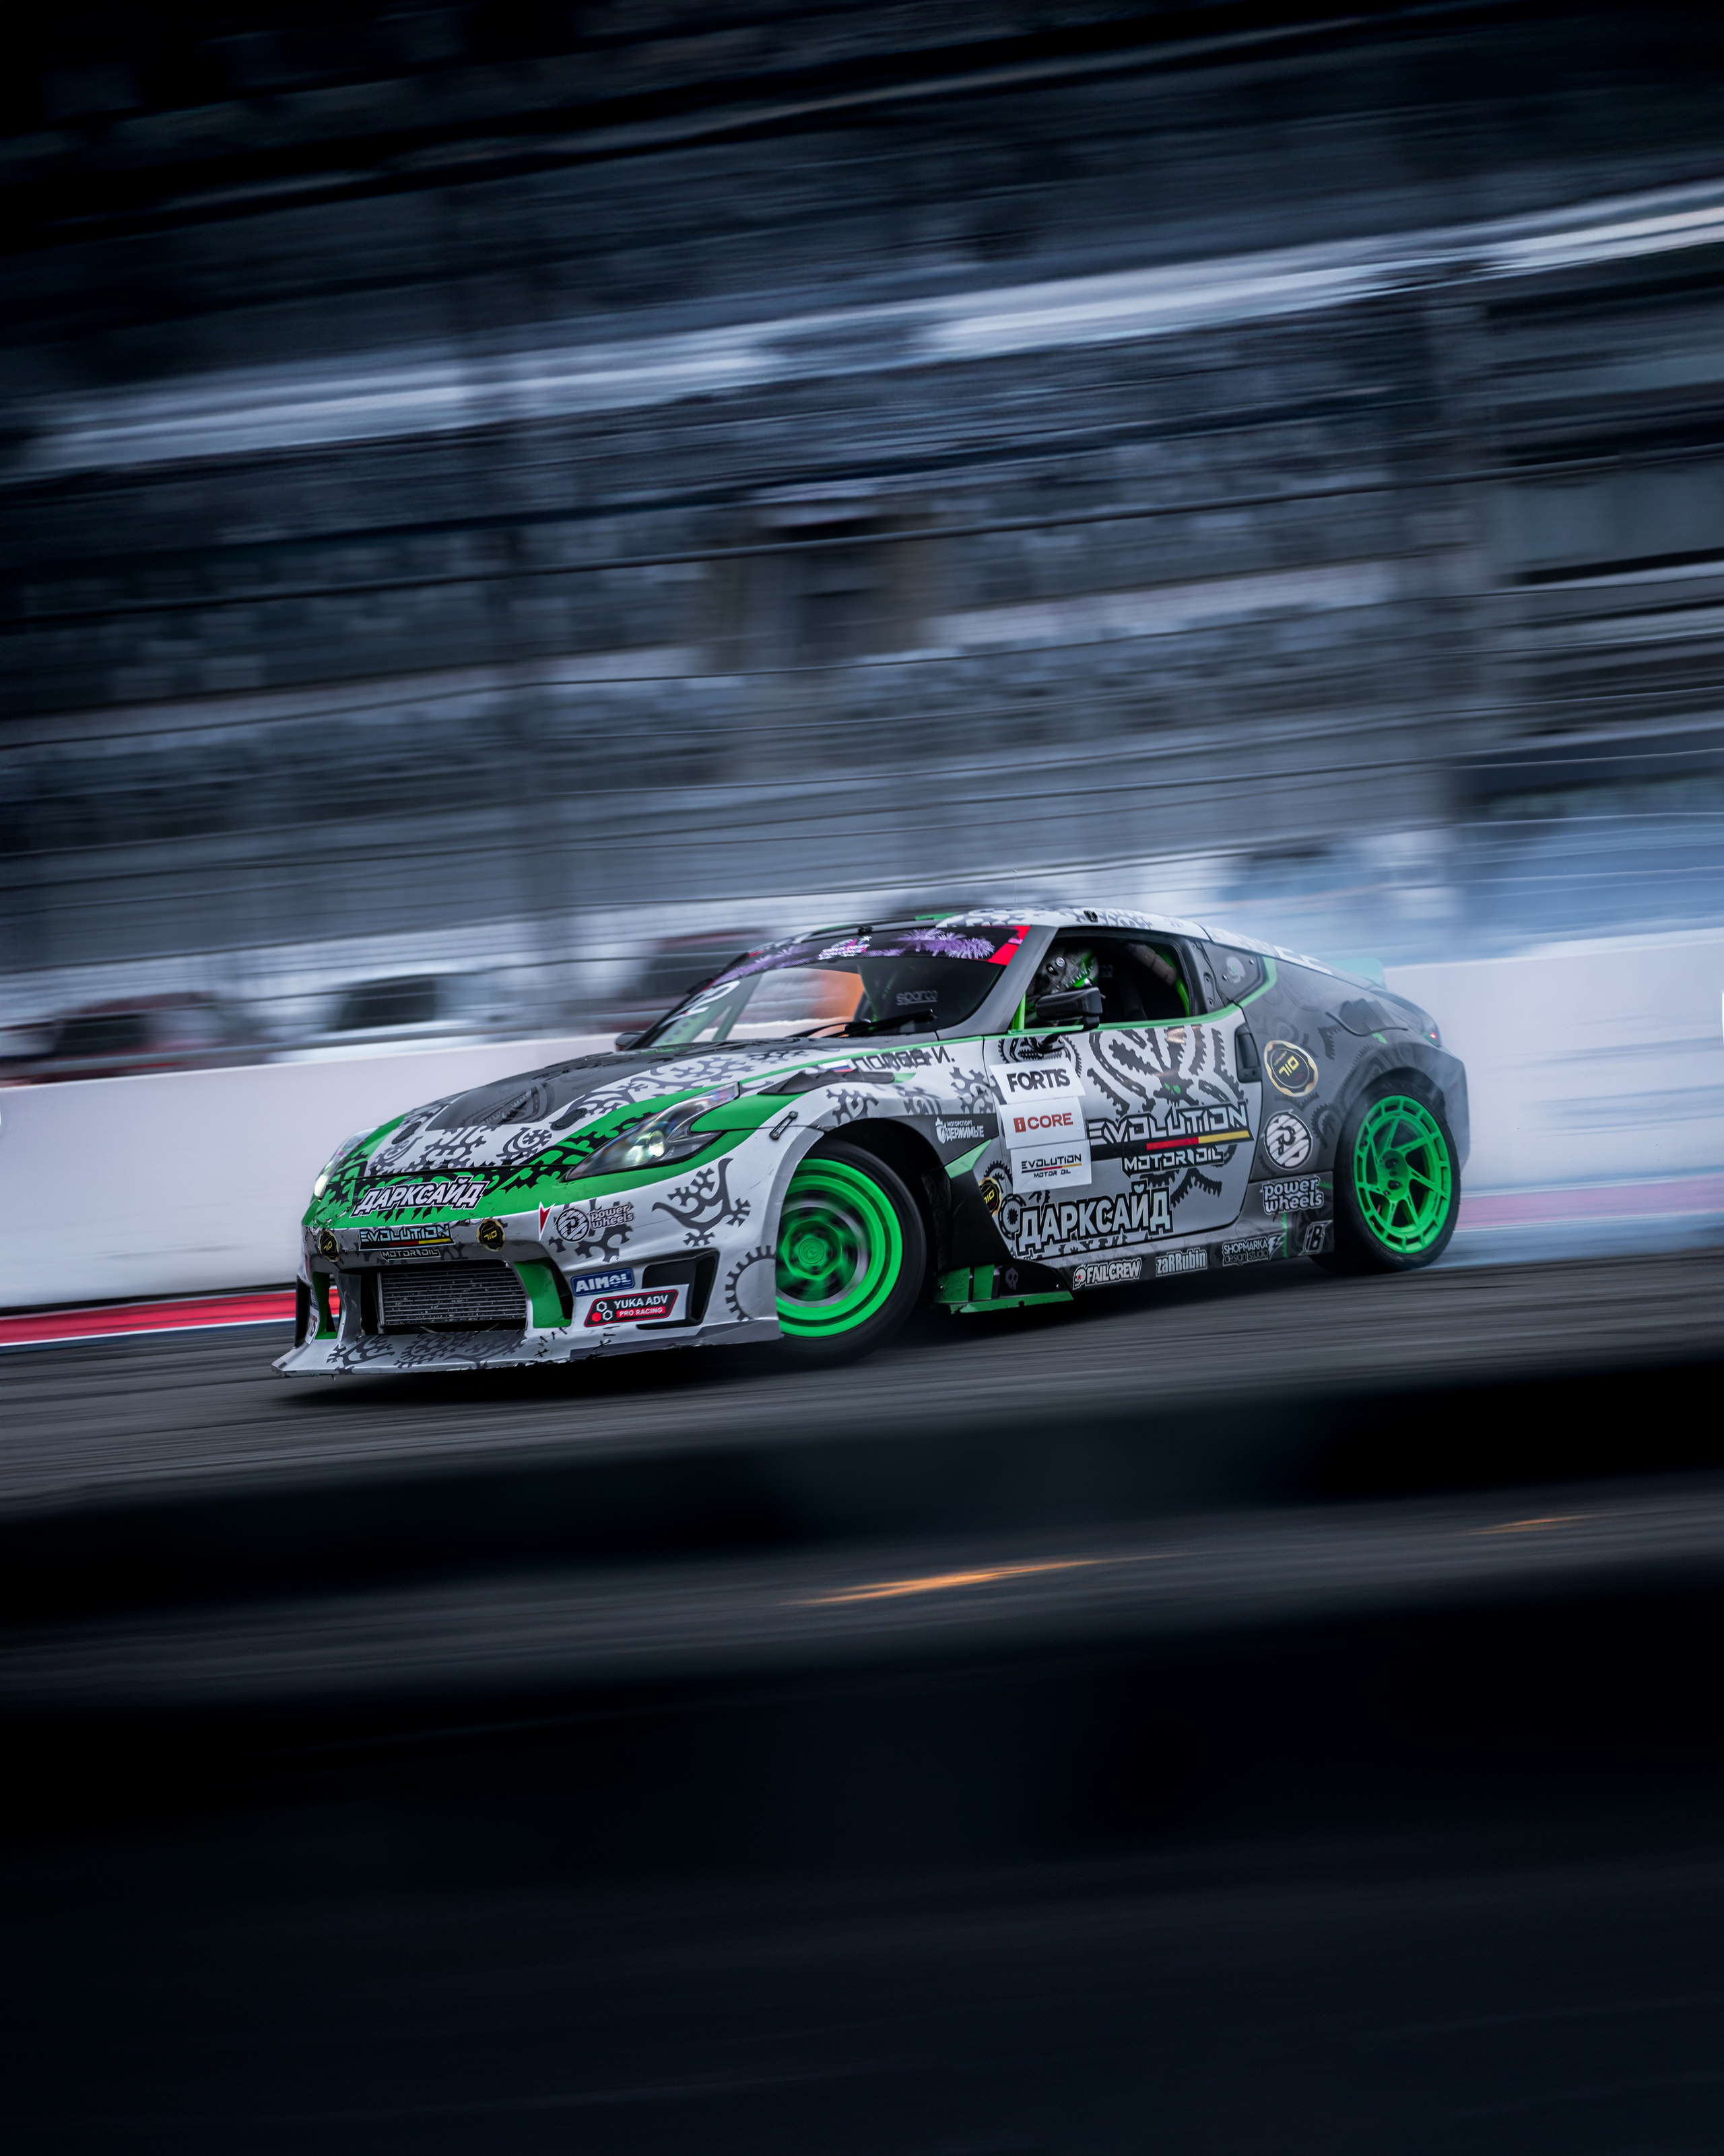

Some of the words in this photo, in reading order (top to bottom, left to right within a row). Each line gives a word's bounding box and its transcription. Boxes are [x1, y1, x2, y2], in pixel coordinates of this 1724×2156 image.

[1006, 1068, 1071, 1092] FORTIS
[1088, 1104, 1247, 1146] EVOLUTION
[1021, 1154, 1082, 1169] EVOLUTION
[1124, 1152, 1188, 1171] MOTOR
[1195, 1148, 1222, 1161] OIL
[1034, 1170, 1058, 1178] MOTOR
[354, 1178, 486, 1215] ДАРКСАЙД
[1264, 1179, 1319, 1200] power
[1264, 1191, 1323, 1213] wheels
[591, 1205, 630, 1221] power
[592, 1214, 634, 1229] wheels
[1019, 1183, 1172, 1253] ДАРКСАЙД
[360, 1224, 450, 1242] EVOLUTION
[383, 1249, 417, 1257] MOTOR
[422, 1248, 438, 1256] OIL
[1224, 1239, 1268, 1254] SHOPMARKA
[1157, 1250, 1206, 1274] zaRRubin
[614, 1297, 645, 1309] YUKA
[646, 1295, 669, 1306] ADV
[635, 1307, 663, 1315] RACING
